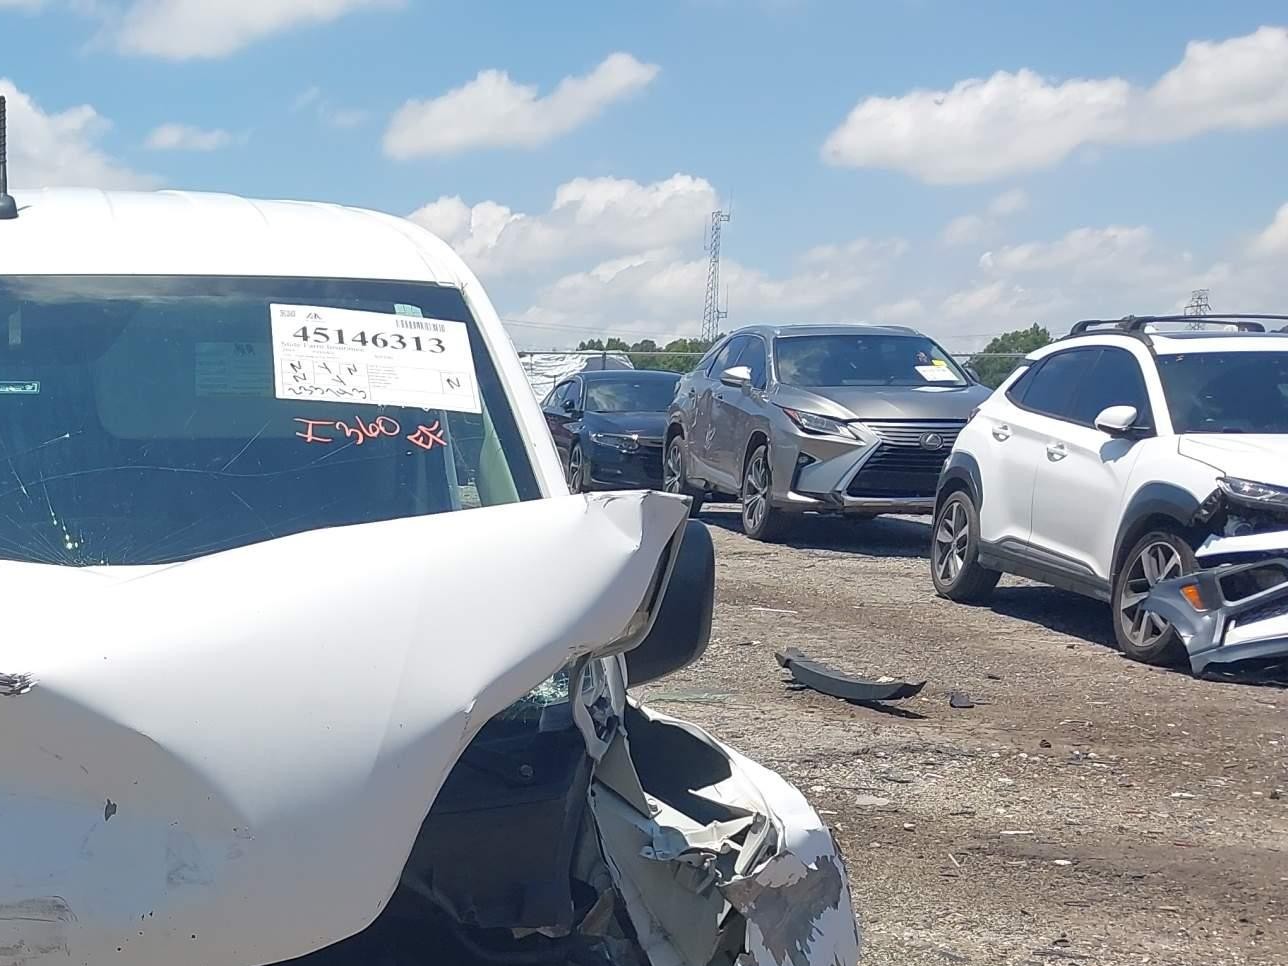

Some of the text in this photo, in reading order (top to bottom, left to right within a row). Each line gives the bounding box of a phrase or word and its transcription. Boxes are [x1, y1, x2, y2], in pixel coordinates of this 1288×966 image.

[293, 325, 446, 354] 45146313
[290, 360, 302, 373] N
[347, 363, 358, 376] N
[446, 376, 461, 390] N
